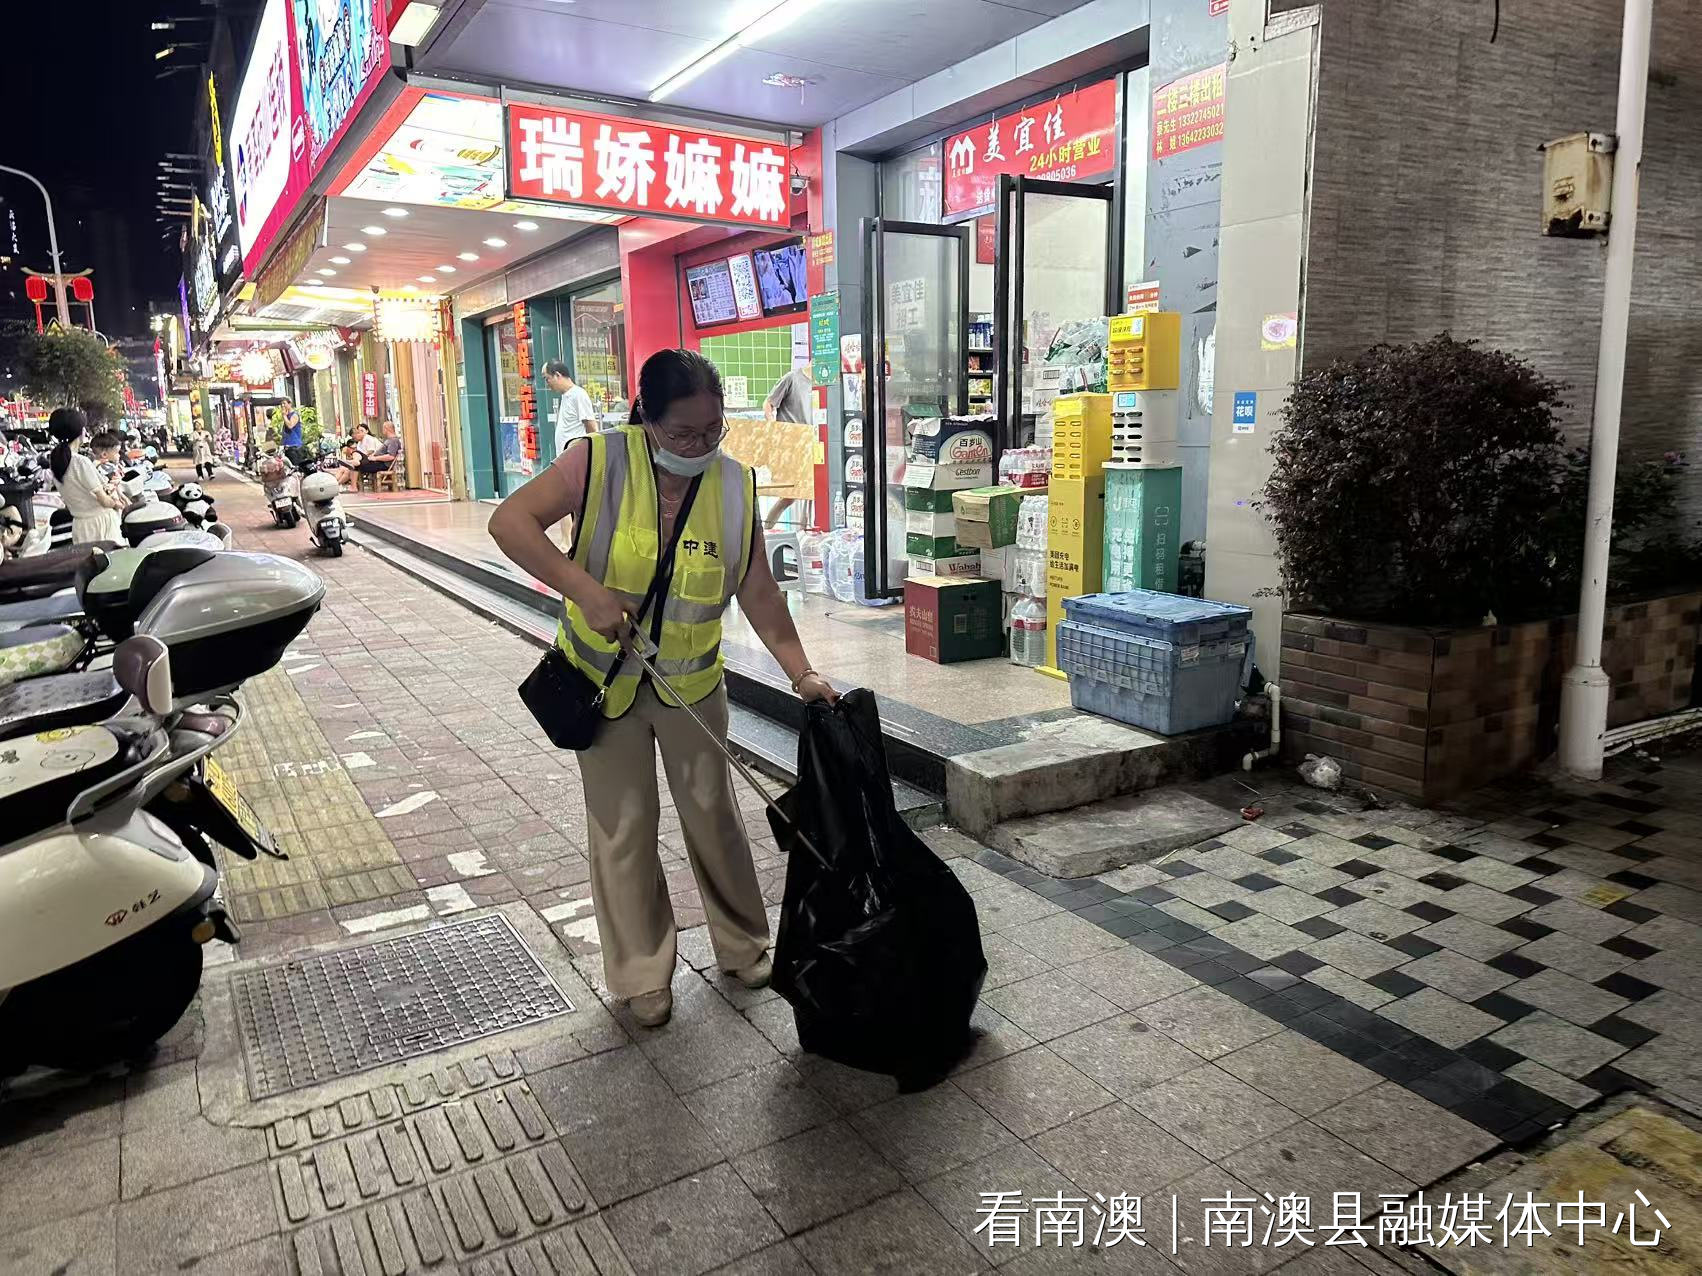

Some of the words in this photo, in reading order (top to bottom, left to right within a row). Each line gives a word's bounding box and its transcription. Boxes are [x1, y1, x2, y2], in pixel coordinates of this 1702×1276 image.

[983, 104, 1065, 162] 美宜佳
[1029, 144, 1101, 172] 24小时营业
[960, 437, 982, 448] 百岁山
